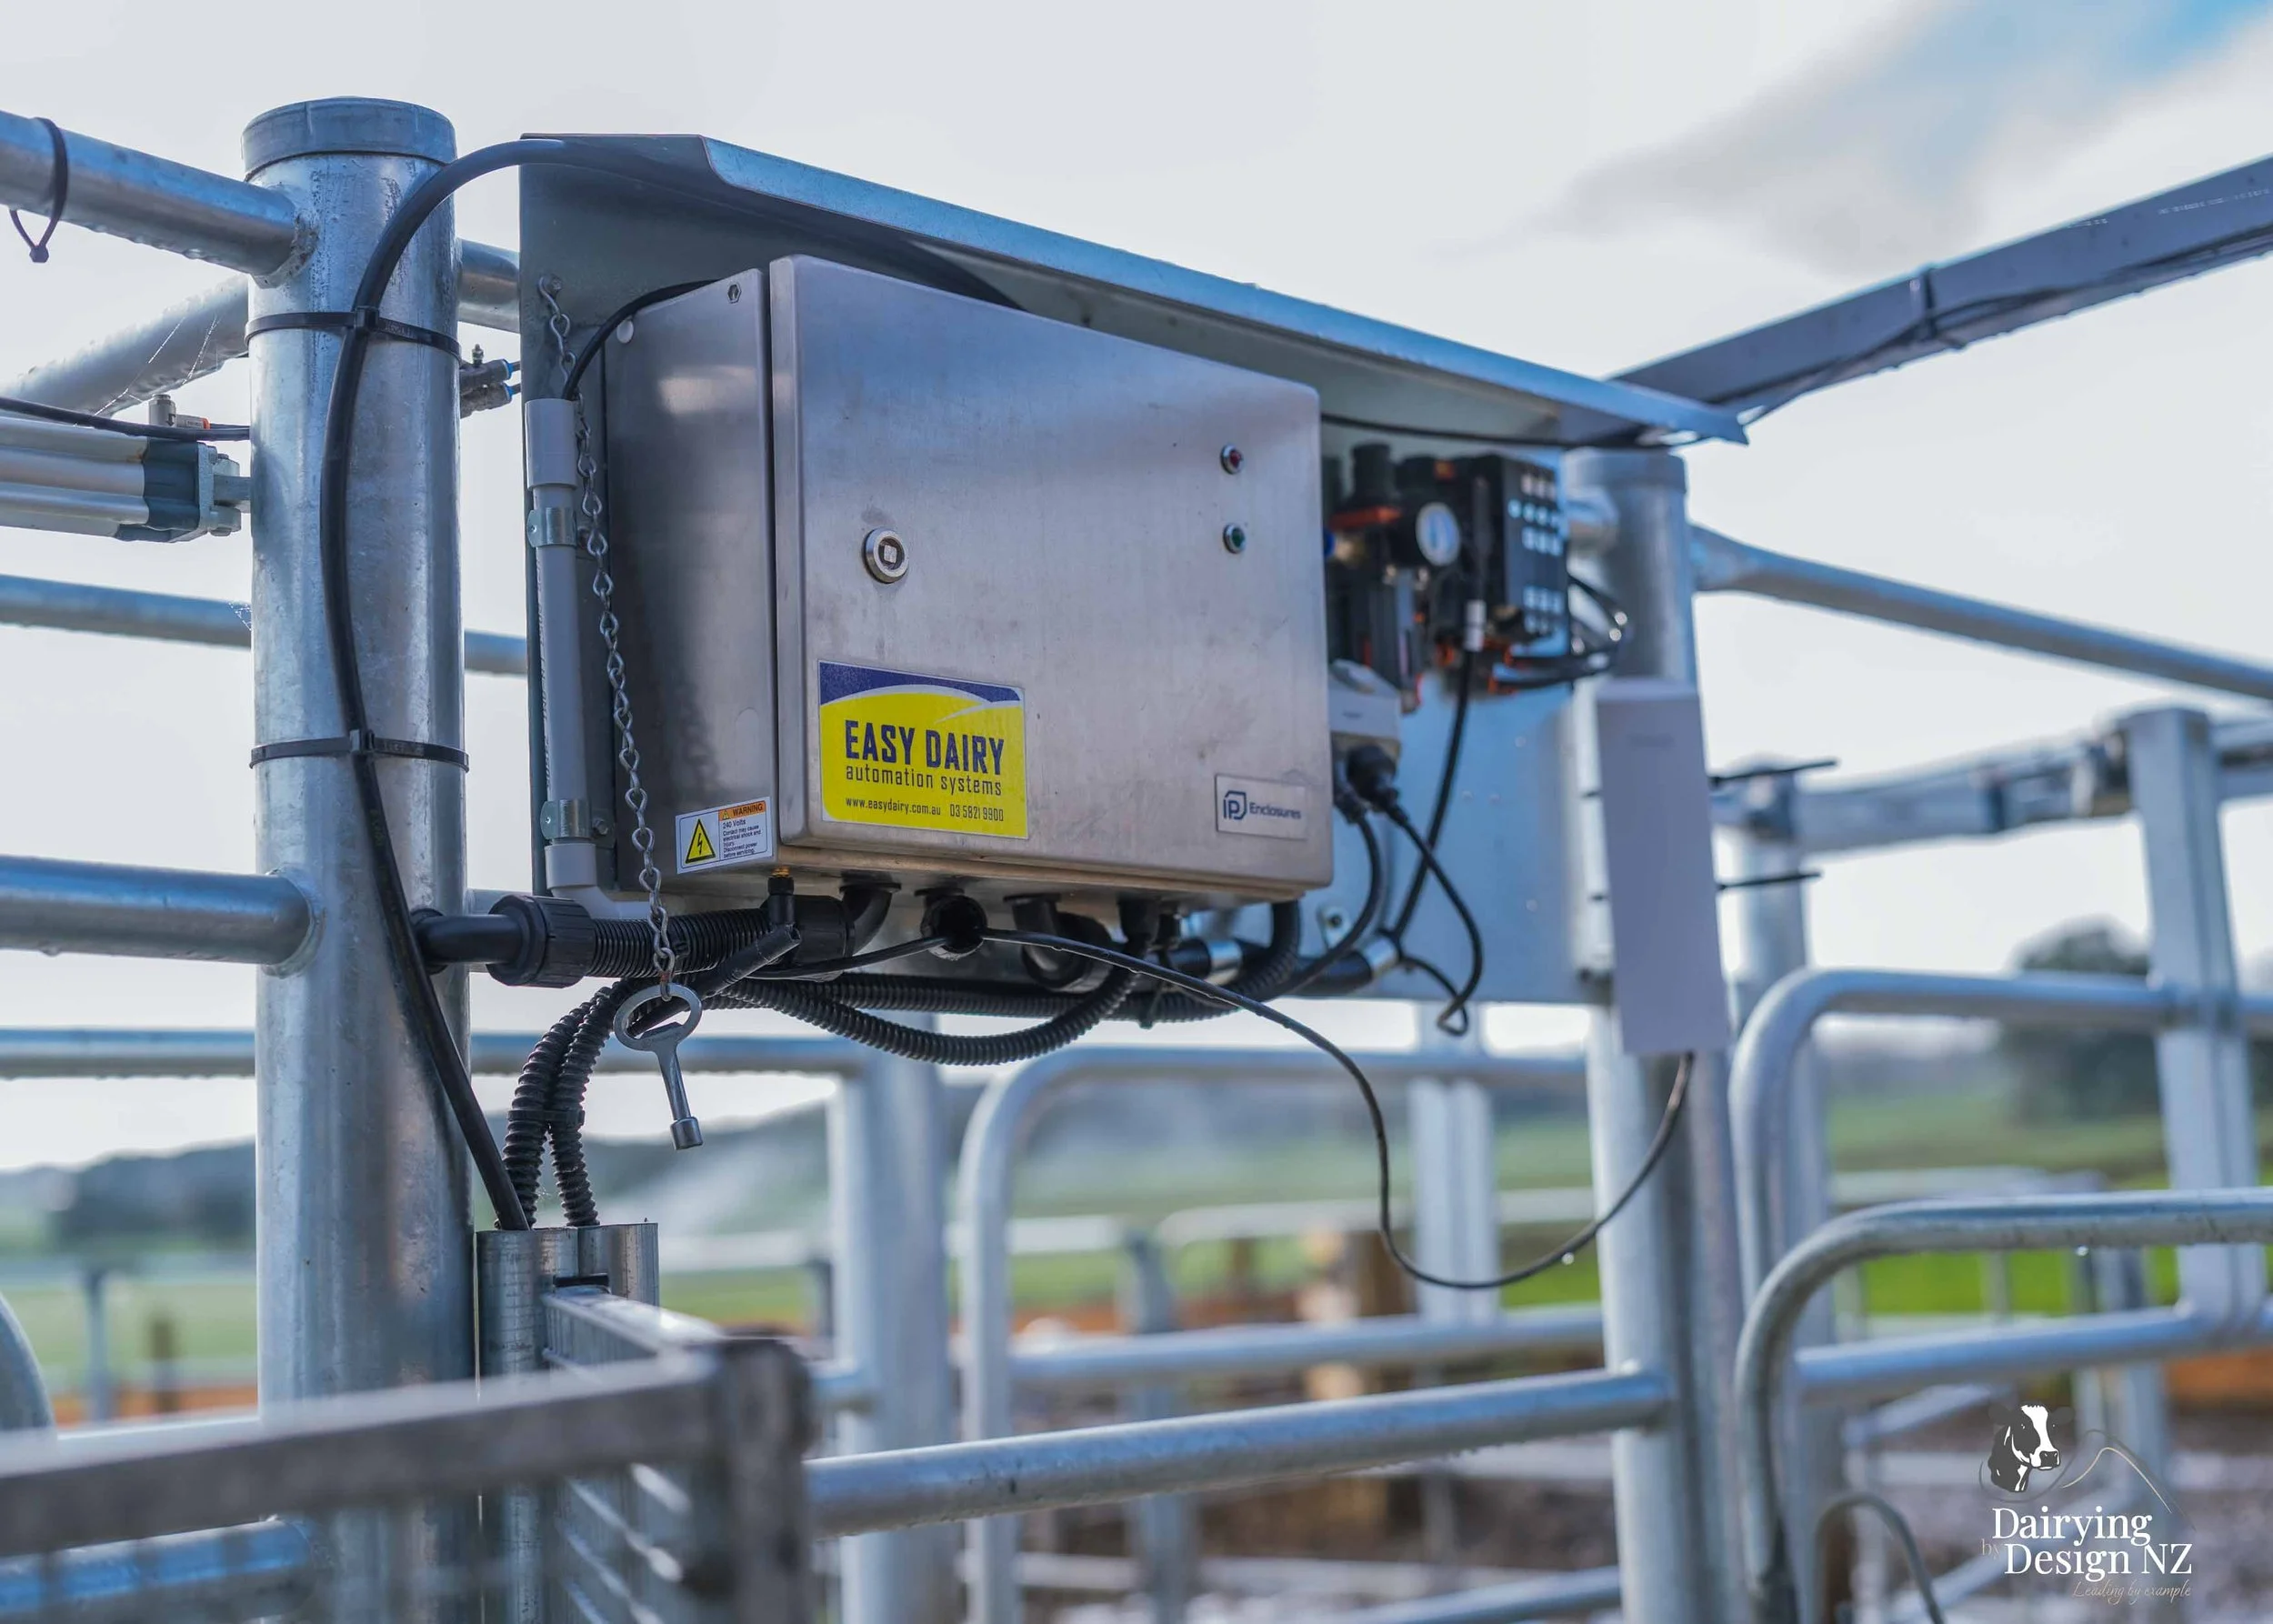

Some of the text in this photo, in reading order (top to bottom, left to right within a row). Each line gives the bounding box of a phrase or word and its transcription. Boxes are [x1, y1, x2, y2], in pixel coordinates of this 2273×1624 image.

[845, 719, 1005, 776] EASY DAIRY
[846, 764, 1002, 796] automation systems
[733, 804, 763, 817] WARNING
[845, 797, 1004, 822] www.easydairy.com.au 03 5821 9900
[1248, 802, 1302, 820] Enclosures
